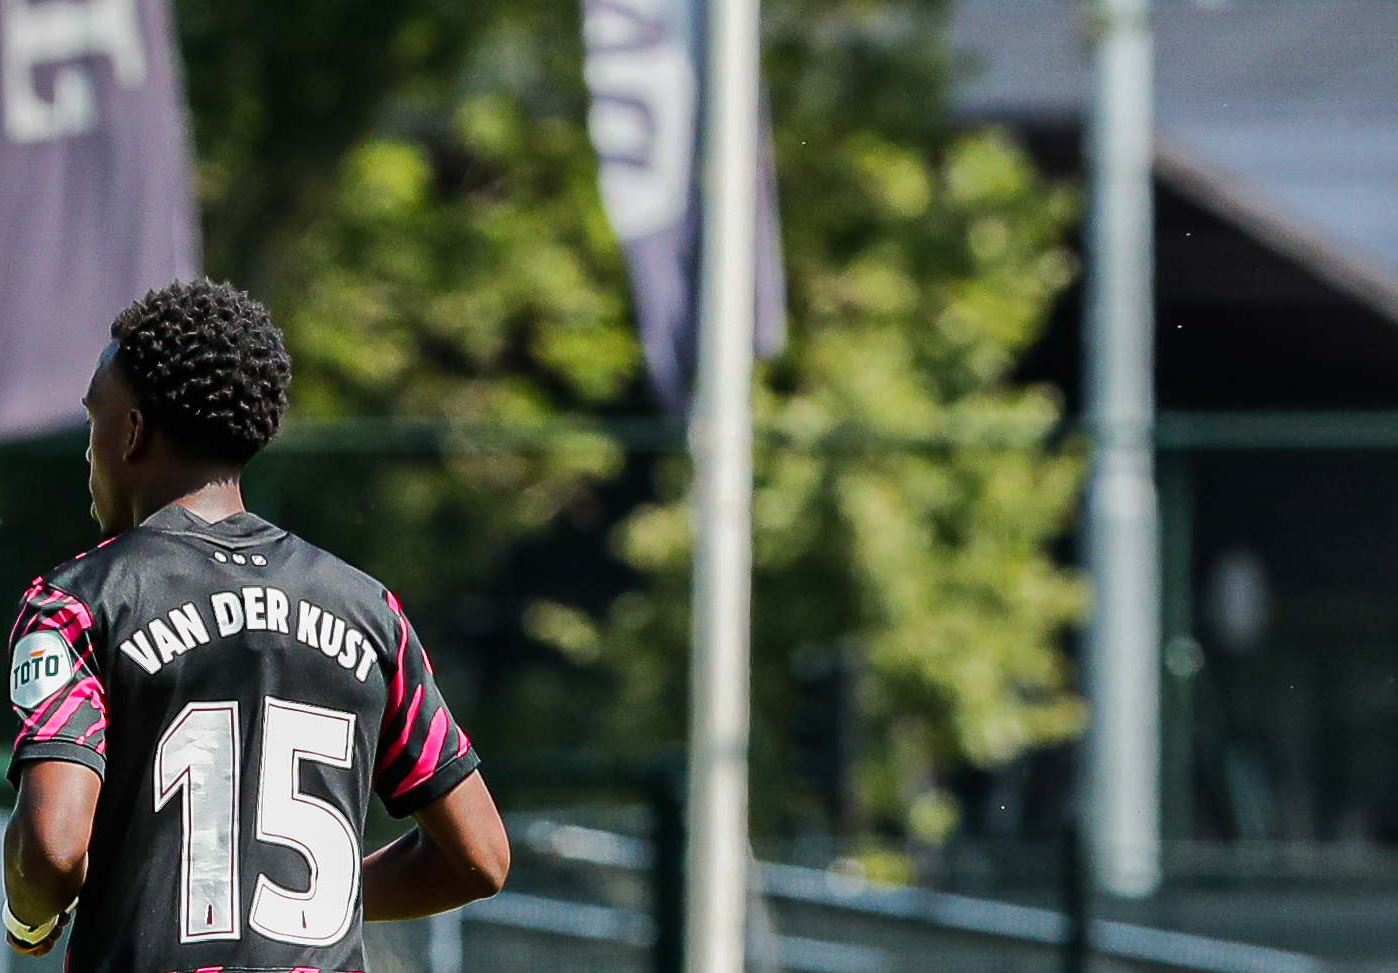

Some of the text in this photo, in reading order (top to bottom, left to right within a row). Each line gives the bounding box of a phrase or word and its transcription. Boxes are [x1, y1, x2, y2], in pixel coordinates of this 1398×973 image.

[13, 654, 60, 691] TOTO
[119, 585, 378, 684] VAN DER KUST
[153, 696, 361, 947] 15
